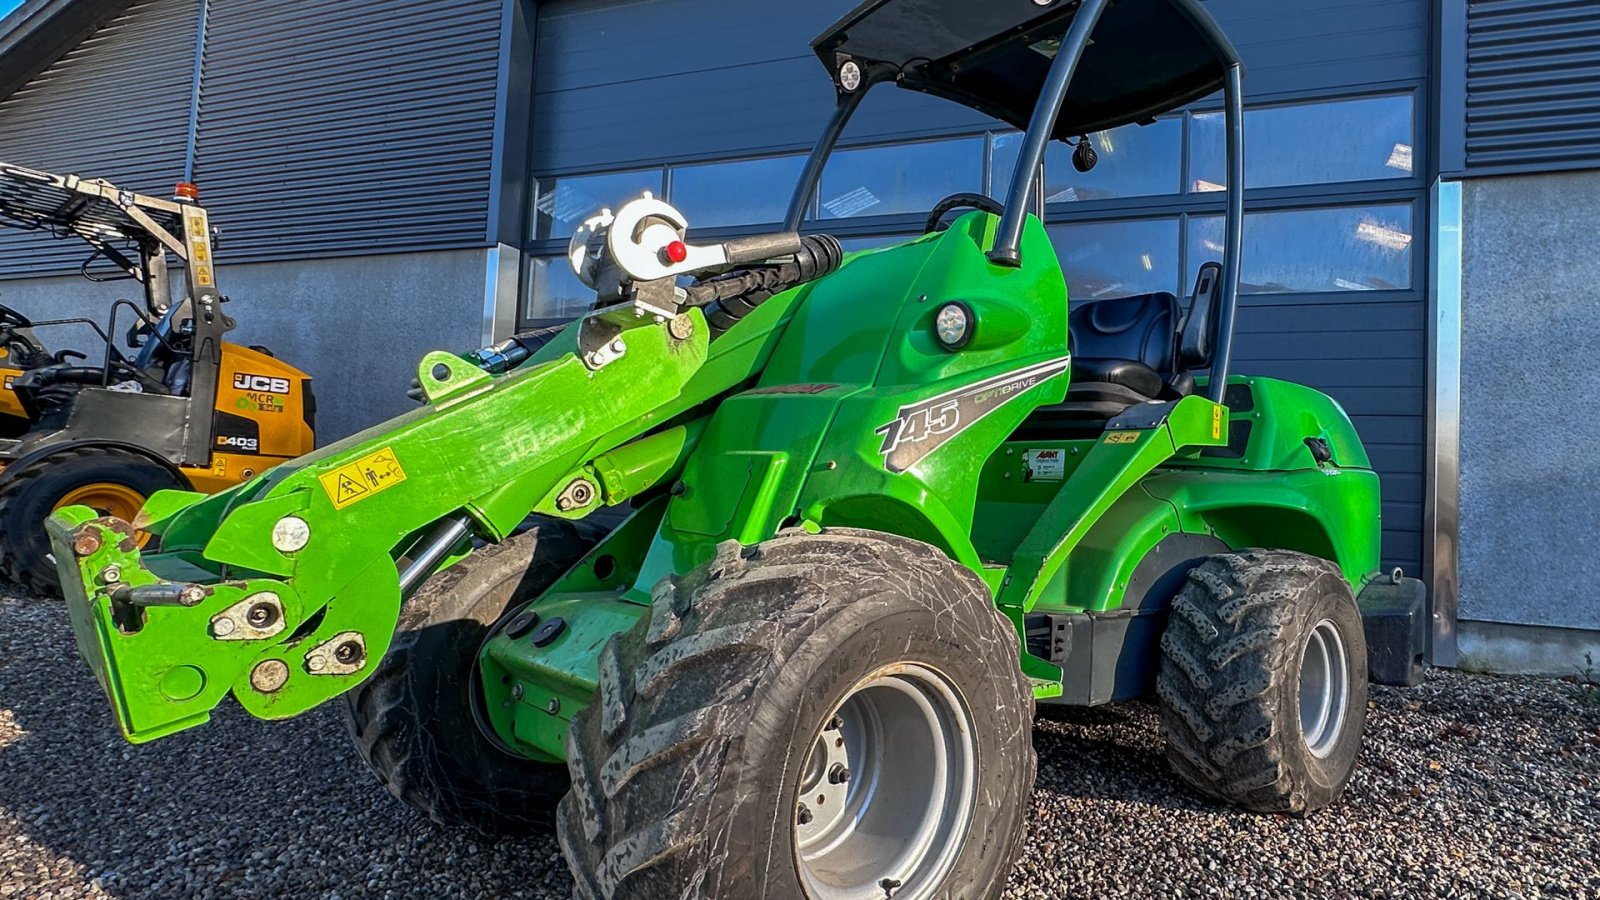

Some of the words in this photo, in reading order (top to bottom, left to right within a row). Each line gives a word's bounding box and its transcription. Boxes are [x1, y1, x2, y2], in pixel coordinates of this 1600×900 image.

[234, 374, 290, 393] JCB
[247, 392, 274, 403] MCR
[874, 399, 960, 455] 745
